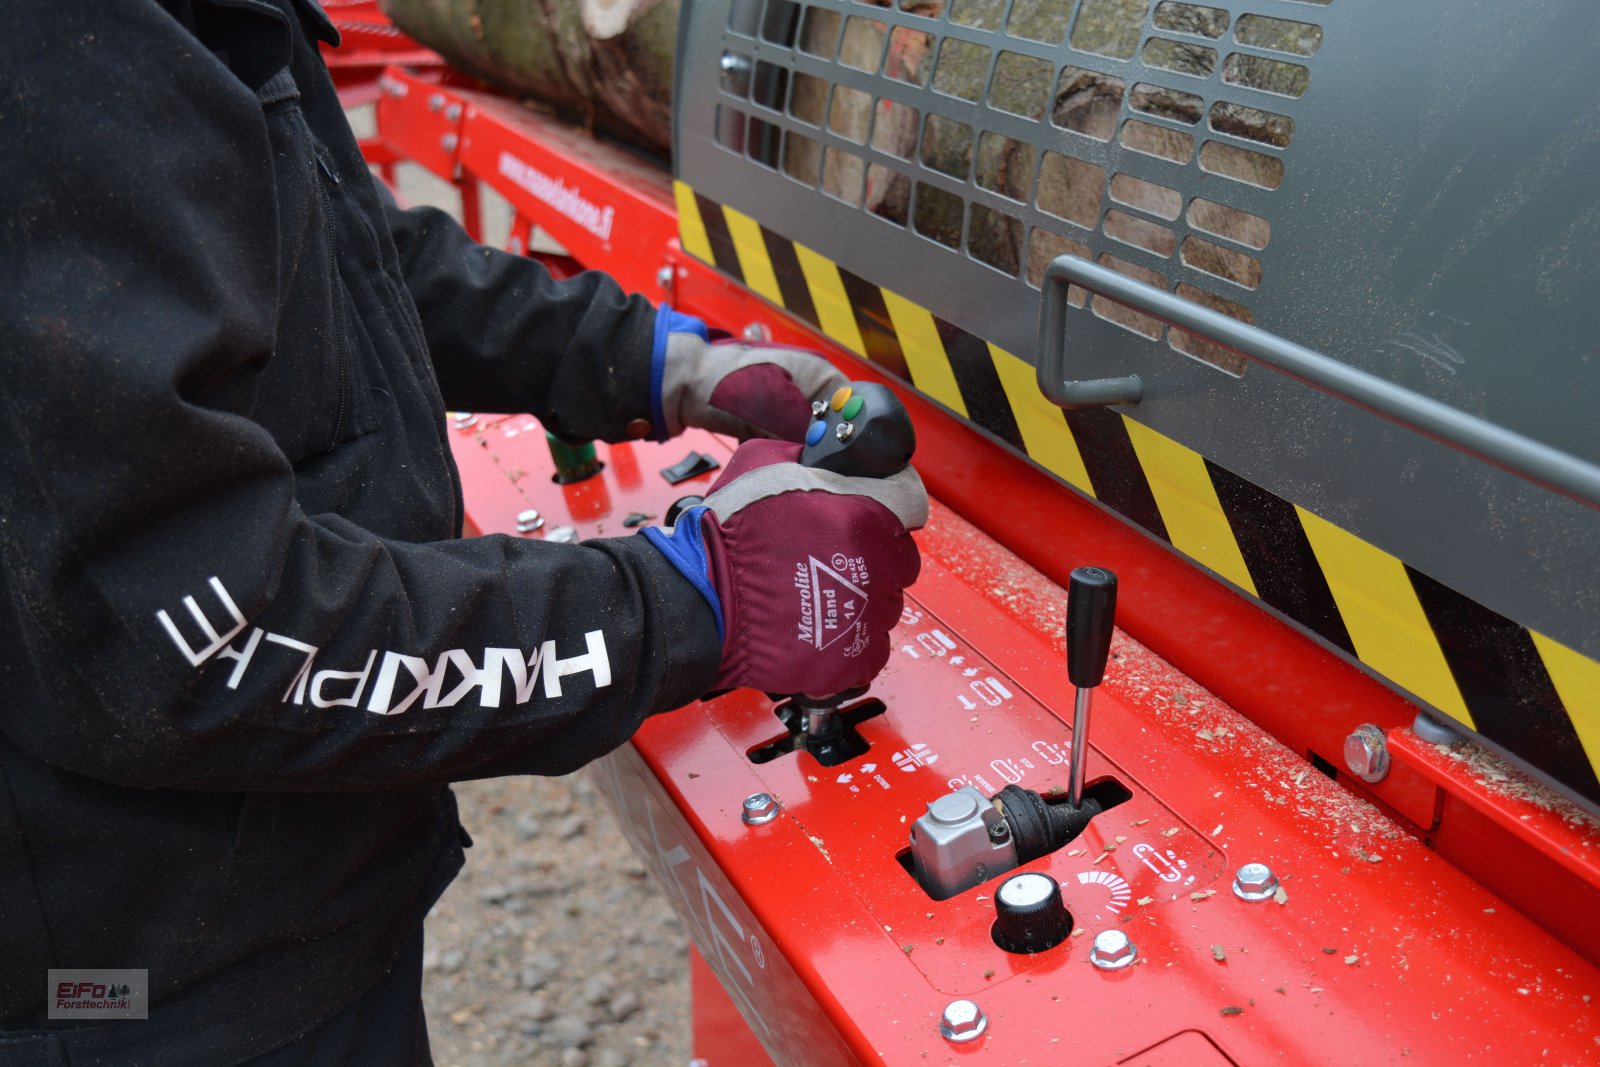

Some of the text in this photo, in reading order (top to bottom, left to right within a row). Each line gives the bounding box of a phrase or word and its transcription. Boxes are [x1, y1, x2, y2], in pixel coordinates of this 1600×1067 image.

[835, 558, 845, 566] 9
[853, 574, 859, 583] EN
[856, 557, 870, 586] 1055
[794, 563, 813, 644] Macrolite
[823, 589, 838, 629] Hand
[844, 600, 855, 619] 1A
[1020, 758, 1035, 769] STOP
[849, 784, 860, 793] UP
[873, 774, 892, 790] DOWN
